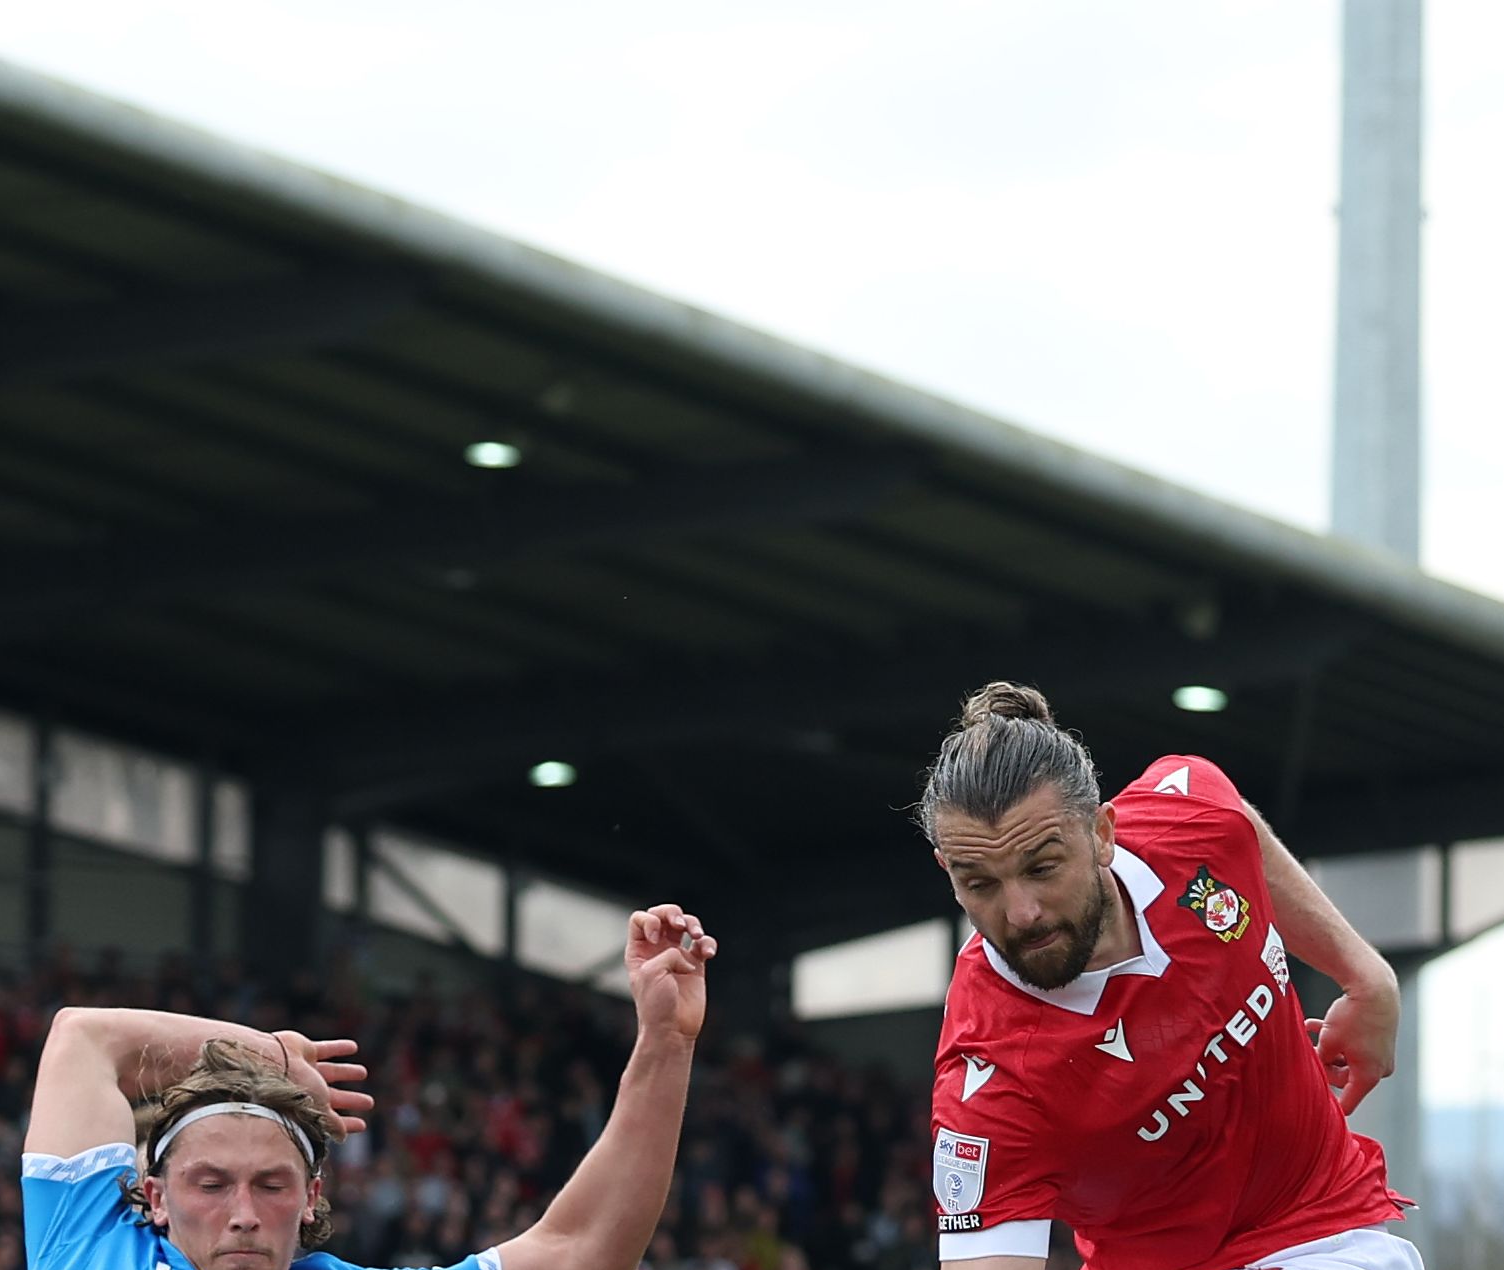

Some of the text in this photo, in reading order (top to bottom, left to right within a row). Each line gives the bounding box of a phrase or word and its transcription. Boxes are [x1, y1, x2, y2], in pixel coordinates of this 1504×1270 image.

[939, 1139, 978, 1158] sky bet
[962, 1160, 977, 1172] ONE
[948, 1198, 959, 1211] EFL
